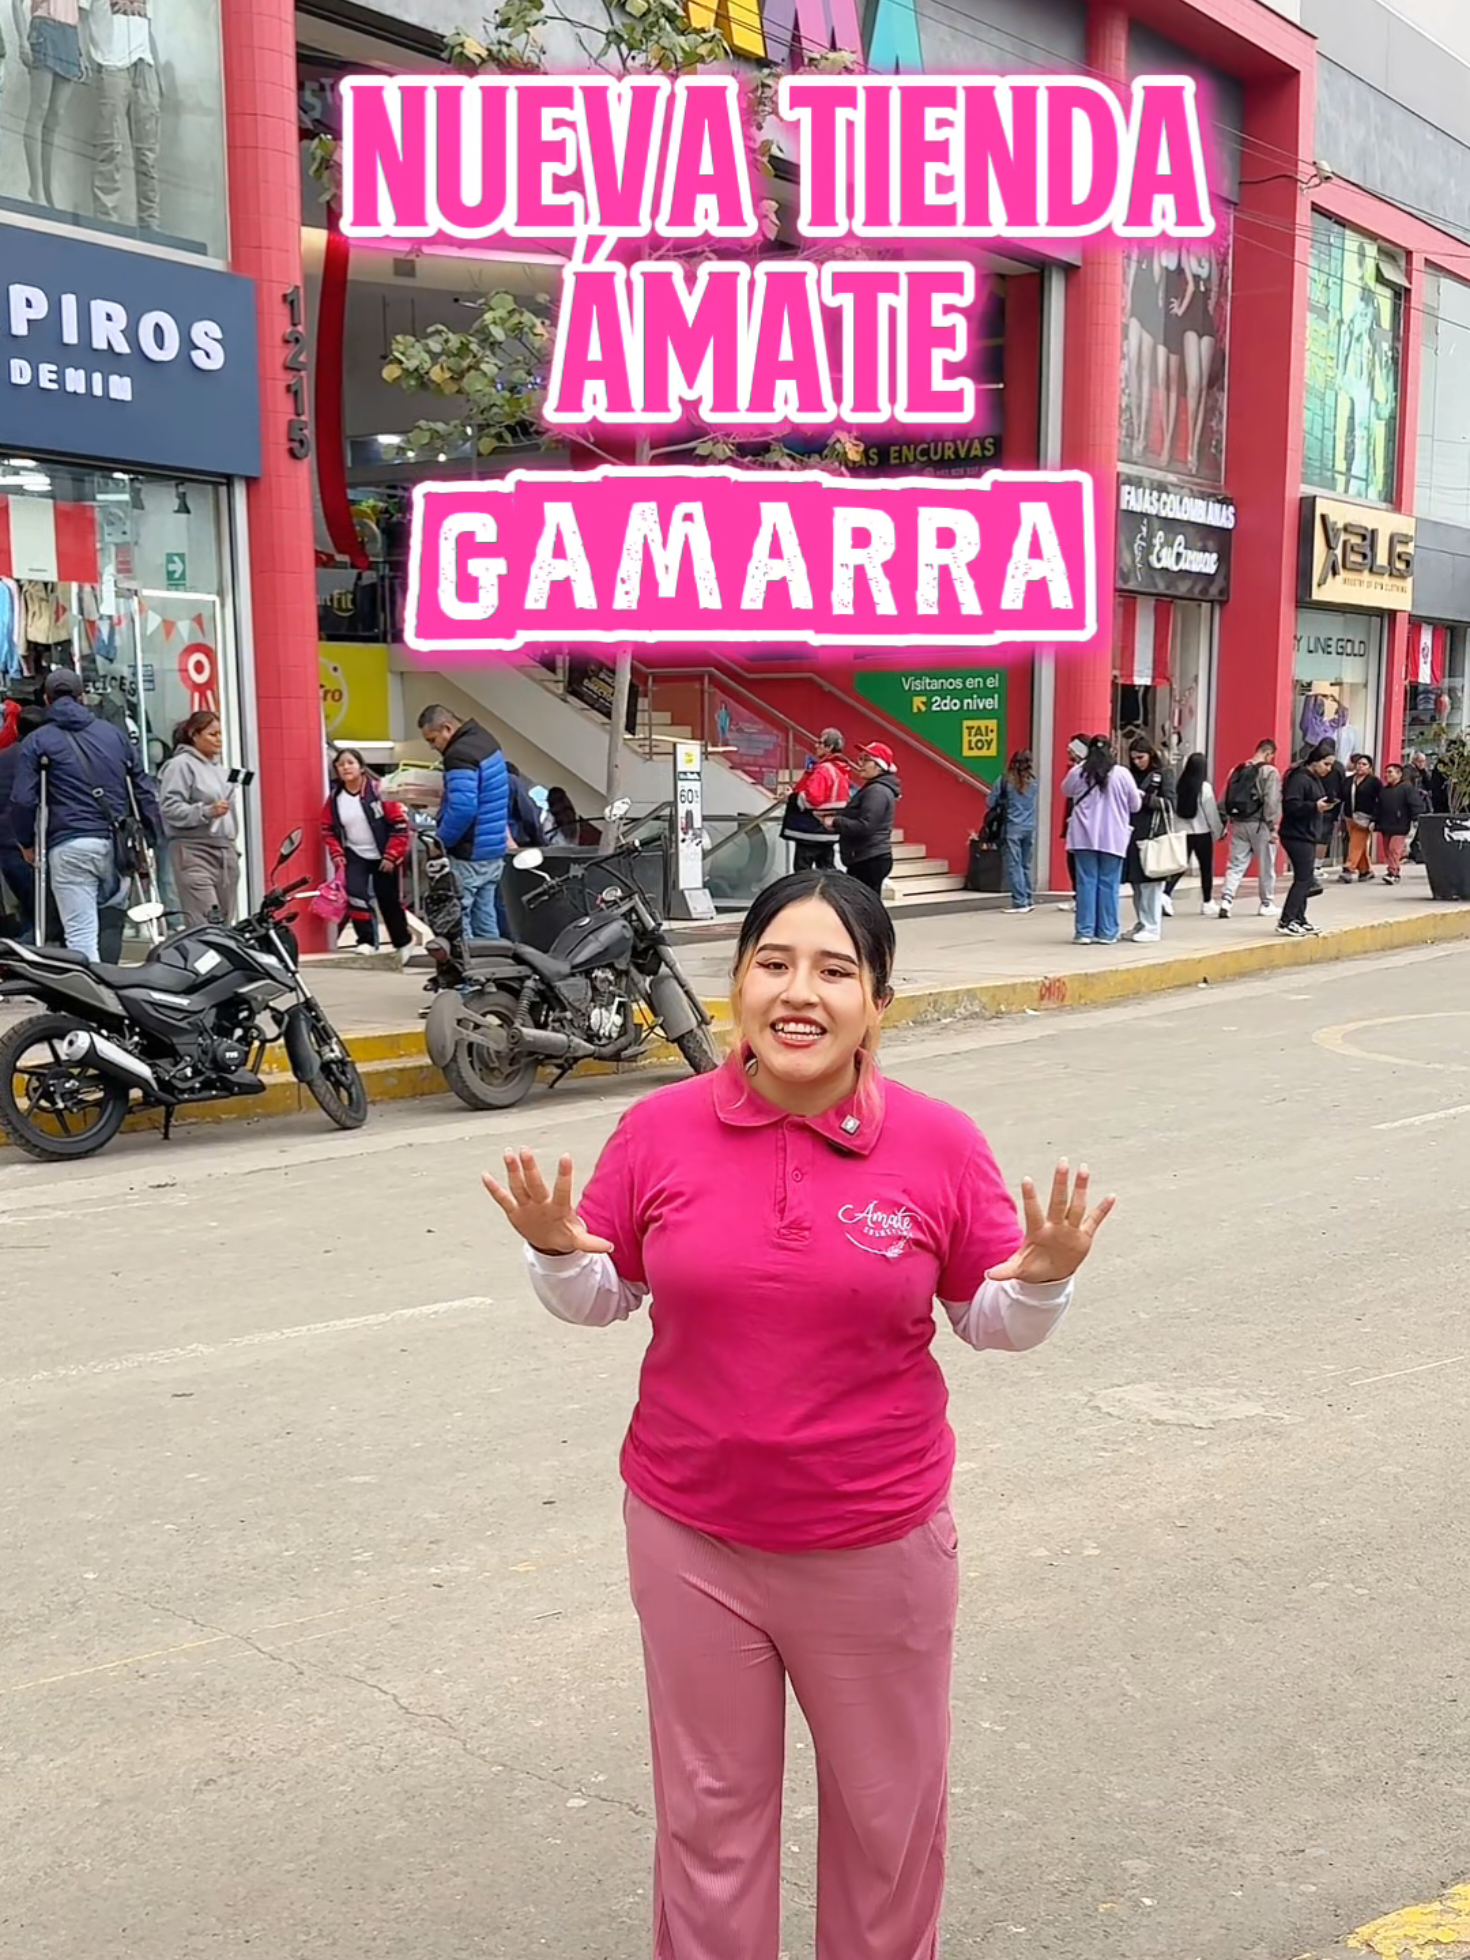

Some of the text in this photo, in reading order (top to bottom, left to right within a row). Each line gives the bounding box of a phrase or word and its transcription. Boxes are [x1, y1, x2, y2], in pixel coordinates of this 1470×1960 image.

[8, 283, 226, 371] PIROS
[9, 357, 133, 402] DENIM
[284, 285, 311, 460] 1215
[889, 437, 996, 466] ENCURVAS
[1157, 491, 1236, 530] COLOMBIANAS
[1307, 636, 1333, 655] LINE
[1336, 638, 1366, 657] GOLD
[965, 677, 984, 689] en
[986, 673, 999, 689] el
[931, 693, 999, 711] 2do nivel
[967, 738, 994, 751] LOY
